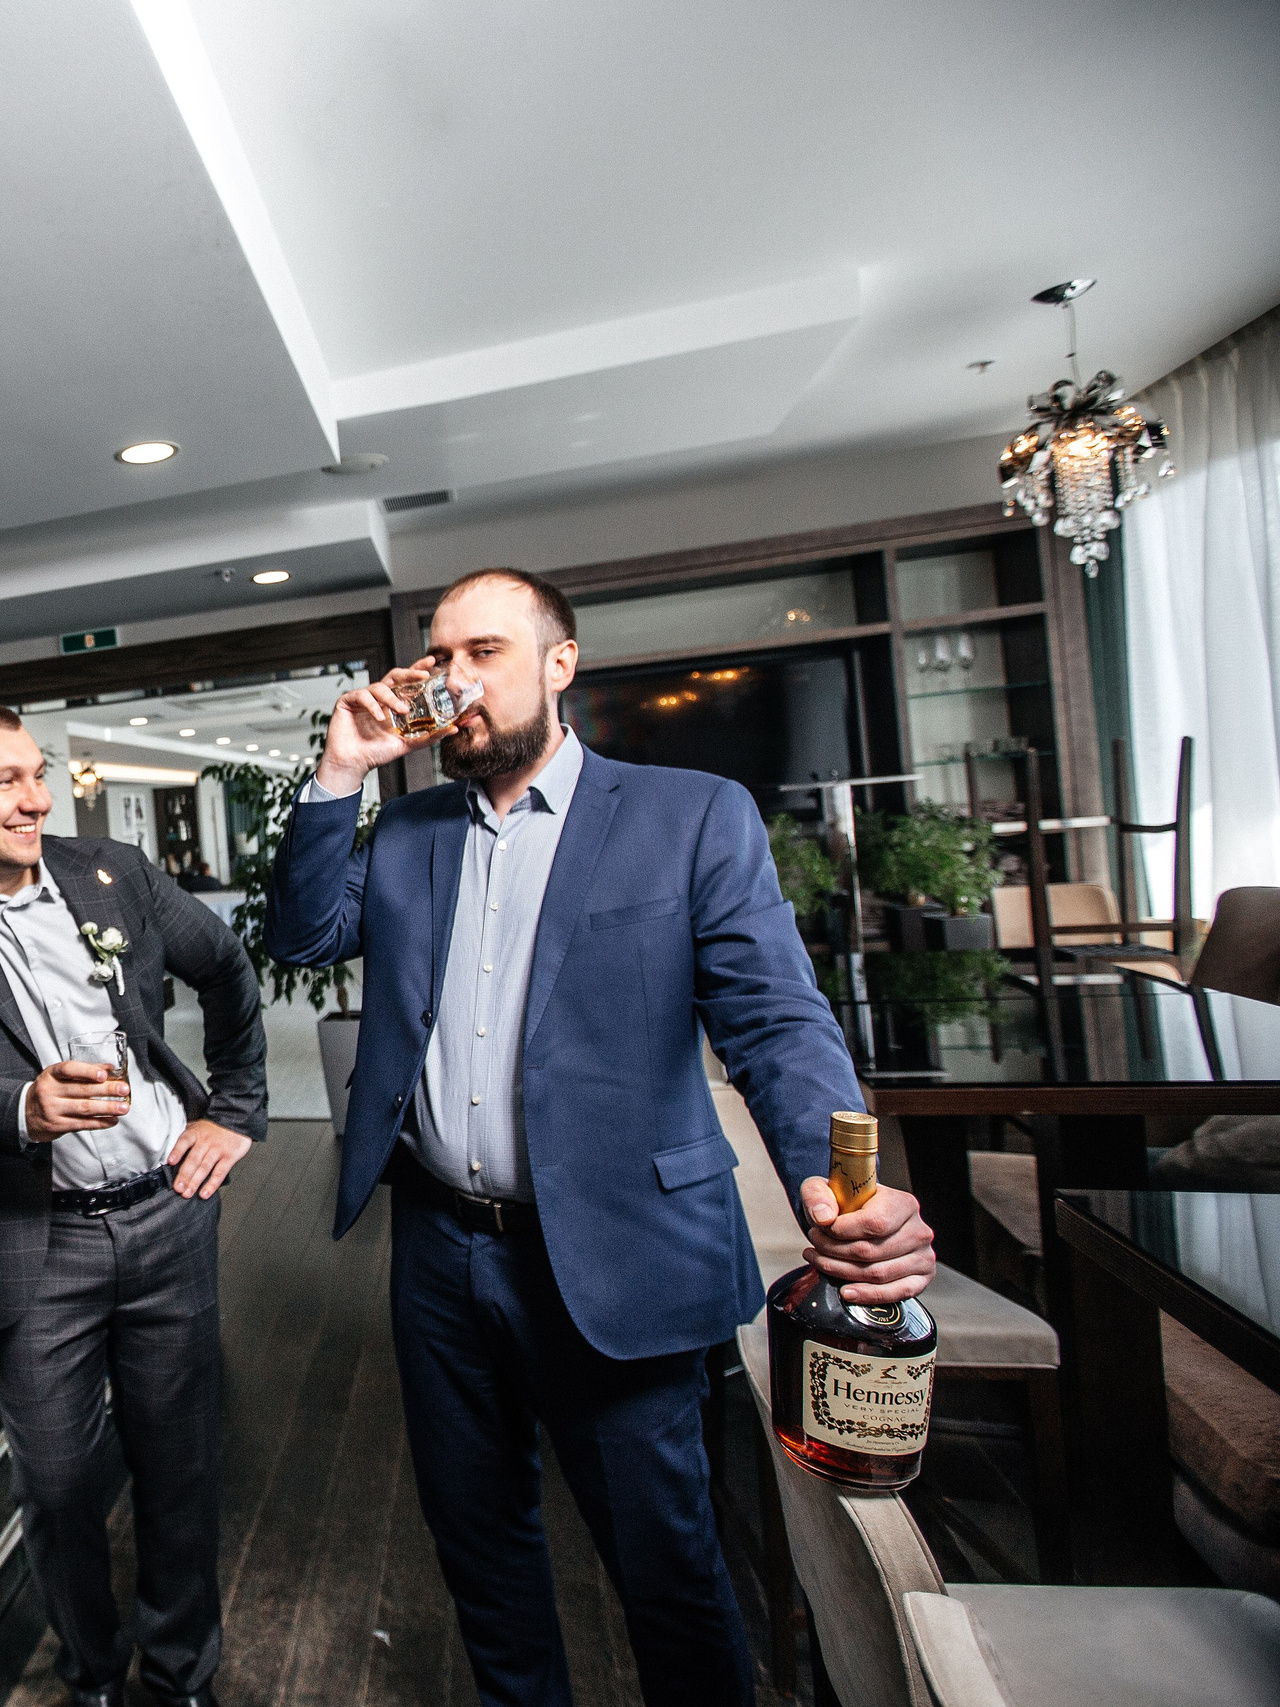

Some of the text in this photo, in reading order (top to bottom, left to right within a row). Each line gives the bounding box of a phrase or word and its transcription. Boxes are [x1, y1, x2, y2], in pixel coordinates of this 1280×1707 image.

[833, 1378, 926, 1406] Hennessy
[843, 1403, 874, 1411] VERY
[862, 1414, 906, 1422] COGNAC
